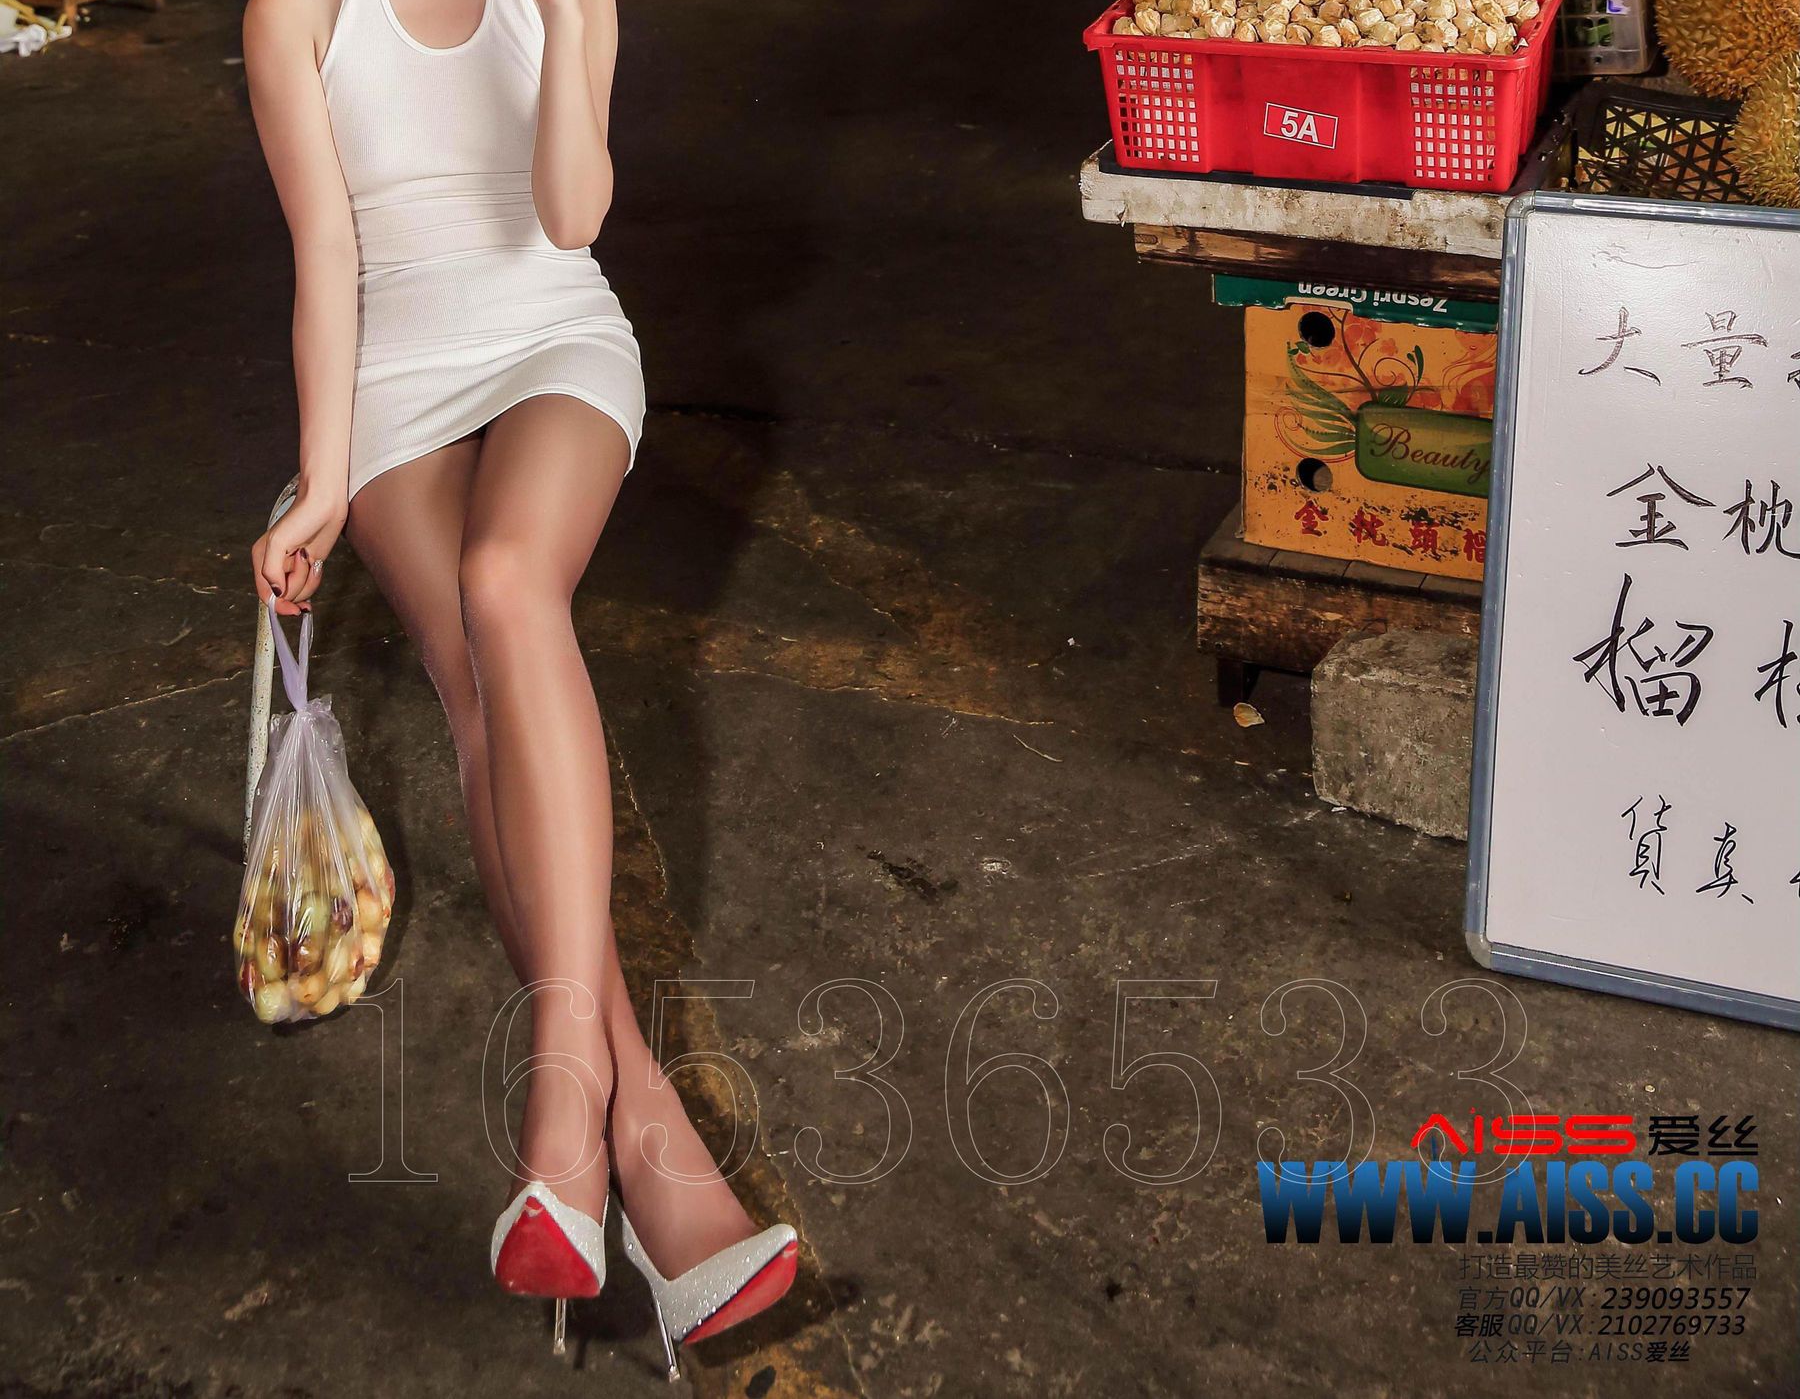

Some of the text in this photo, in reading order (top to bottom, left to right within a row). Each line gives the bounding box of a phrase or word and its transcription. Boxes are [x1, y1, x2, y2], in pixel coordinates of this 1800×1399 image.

[1280, 110, 1319, 143] 5A
[1578, 306, 1800, 390] 大量
[1370, 423, 1491, 484] Beauty
